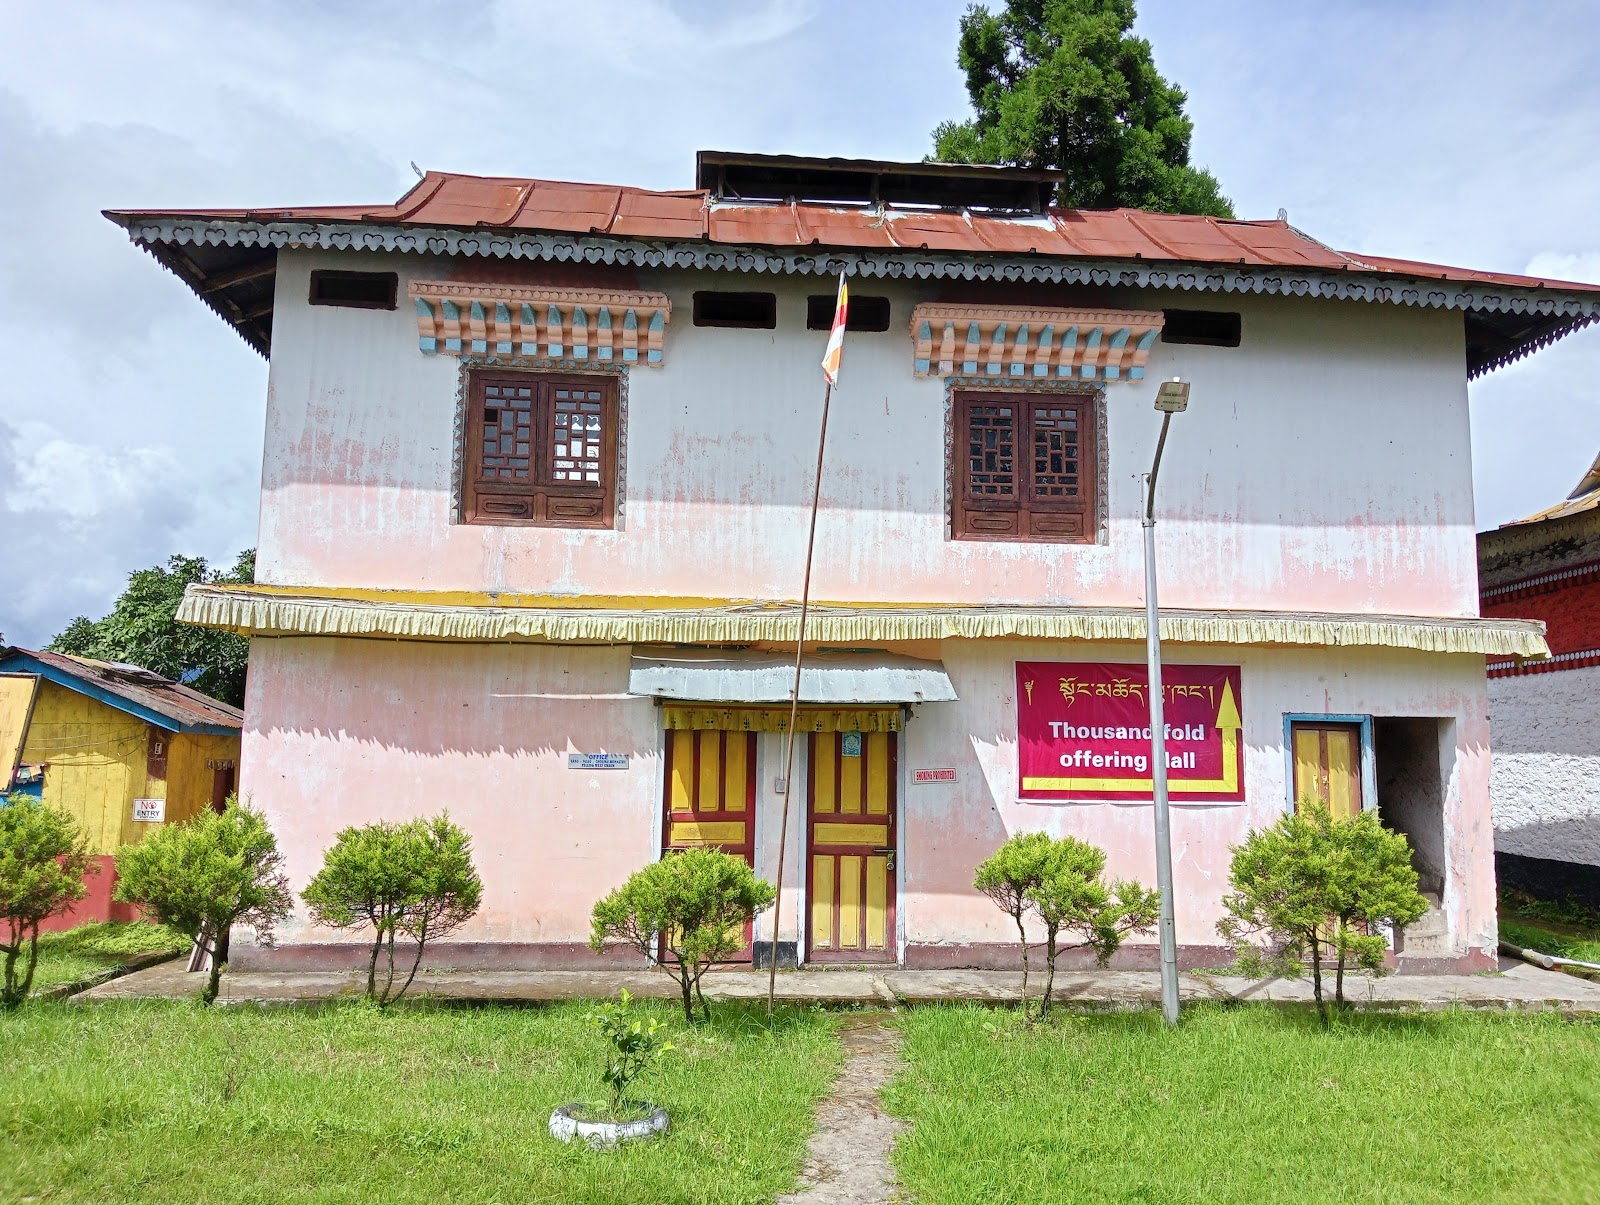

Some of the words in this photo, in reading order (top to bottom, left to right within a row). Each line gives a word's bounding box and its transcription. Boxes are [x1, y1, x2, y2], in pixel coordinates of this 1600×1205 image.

[1048, 721, 1152, 741] Thousand
[1164, 723, 1205, 741] fold
[1060, 750, 1147, 773] offering
[916, 771, 932, 781] SMOKING
[933, 770, 954, 780] PROHIBITED
[141, 800, 157, 810] NO
